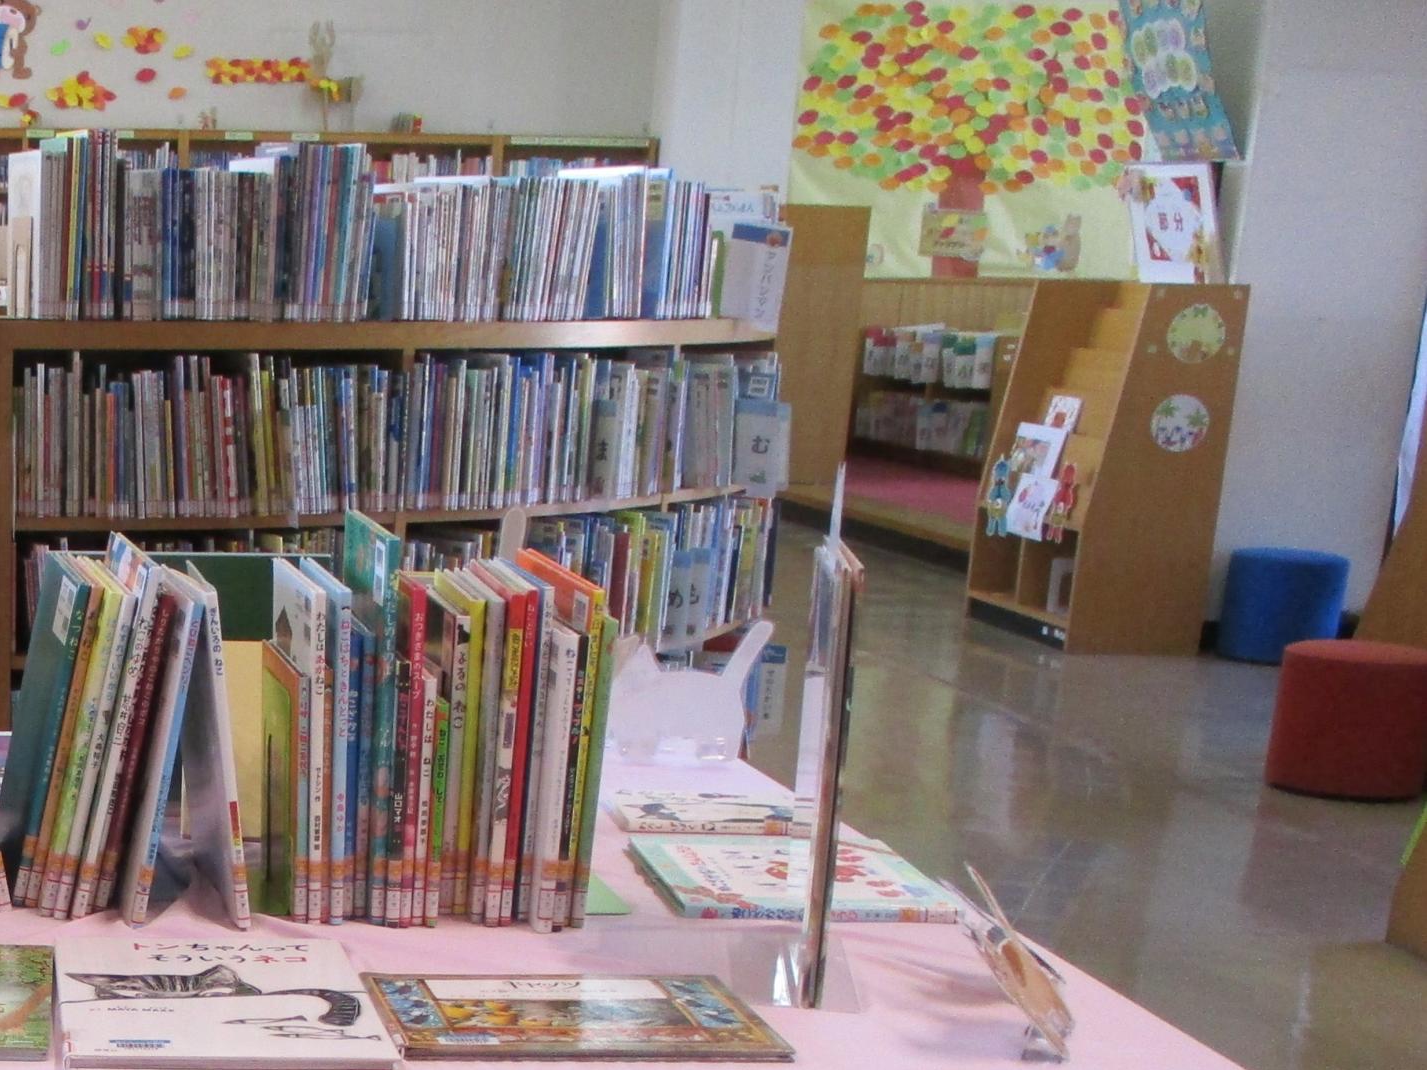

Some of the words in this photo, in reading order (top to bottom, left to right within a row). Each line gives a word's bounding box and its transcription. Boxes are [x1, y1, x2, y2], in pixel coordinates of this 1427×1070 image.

[750, 435, 770, 454] む
[133, 942, 309, 952] トンちゃんって
[147, 953, 308, 964] そういうネコ
